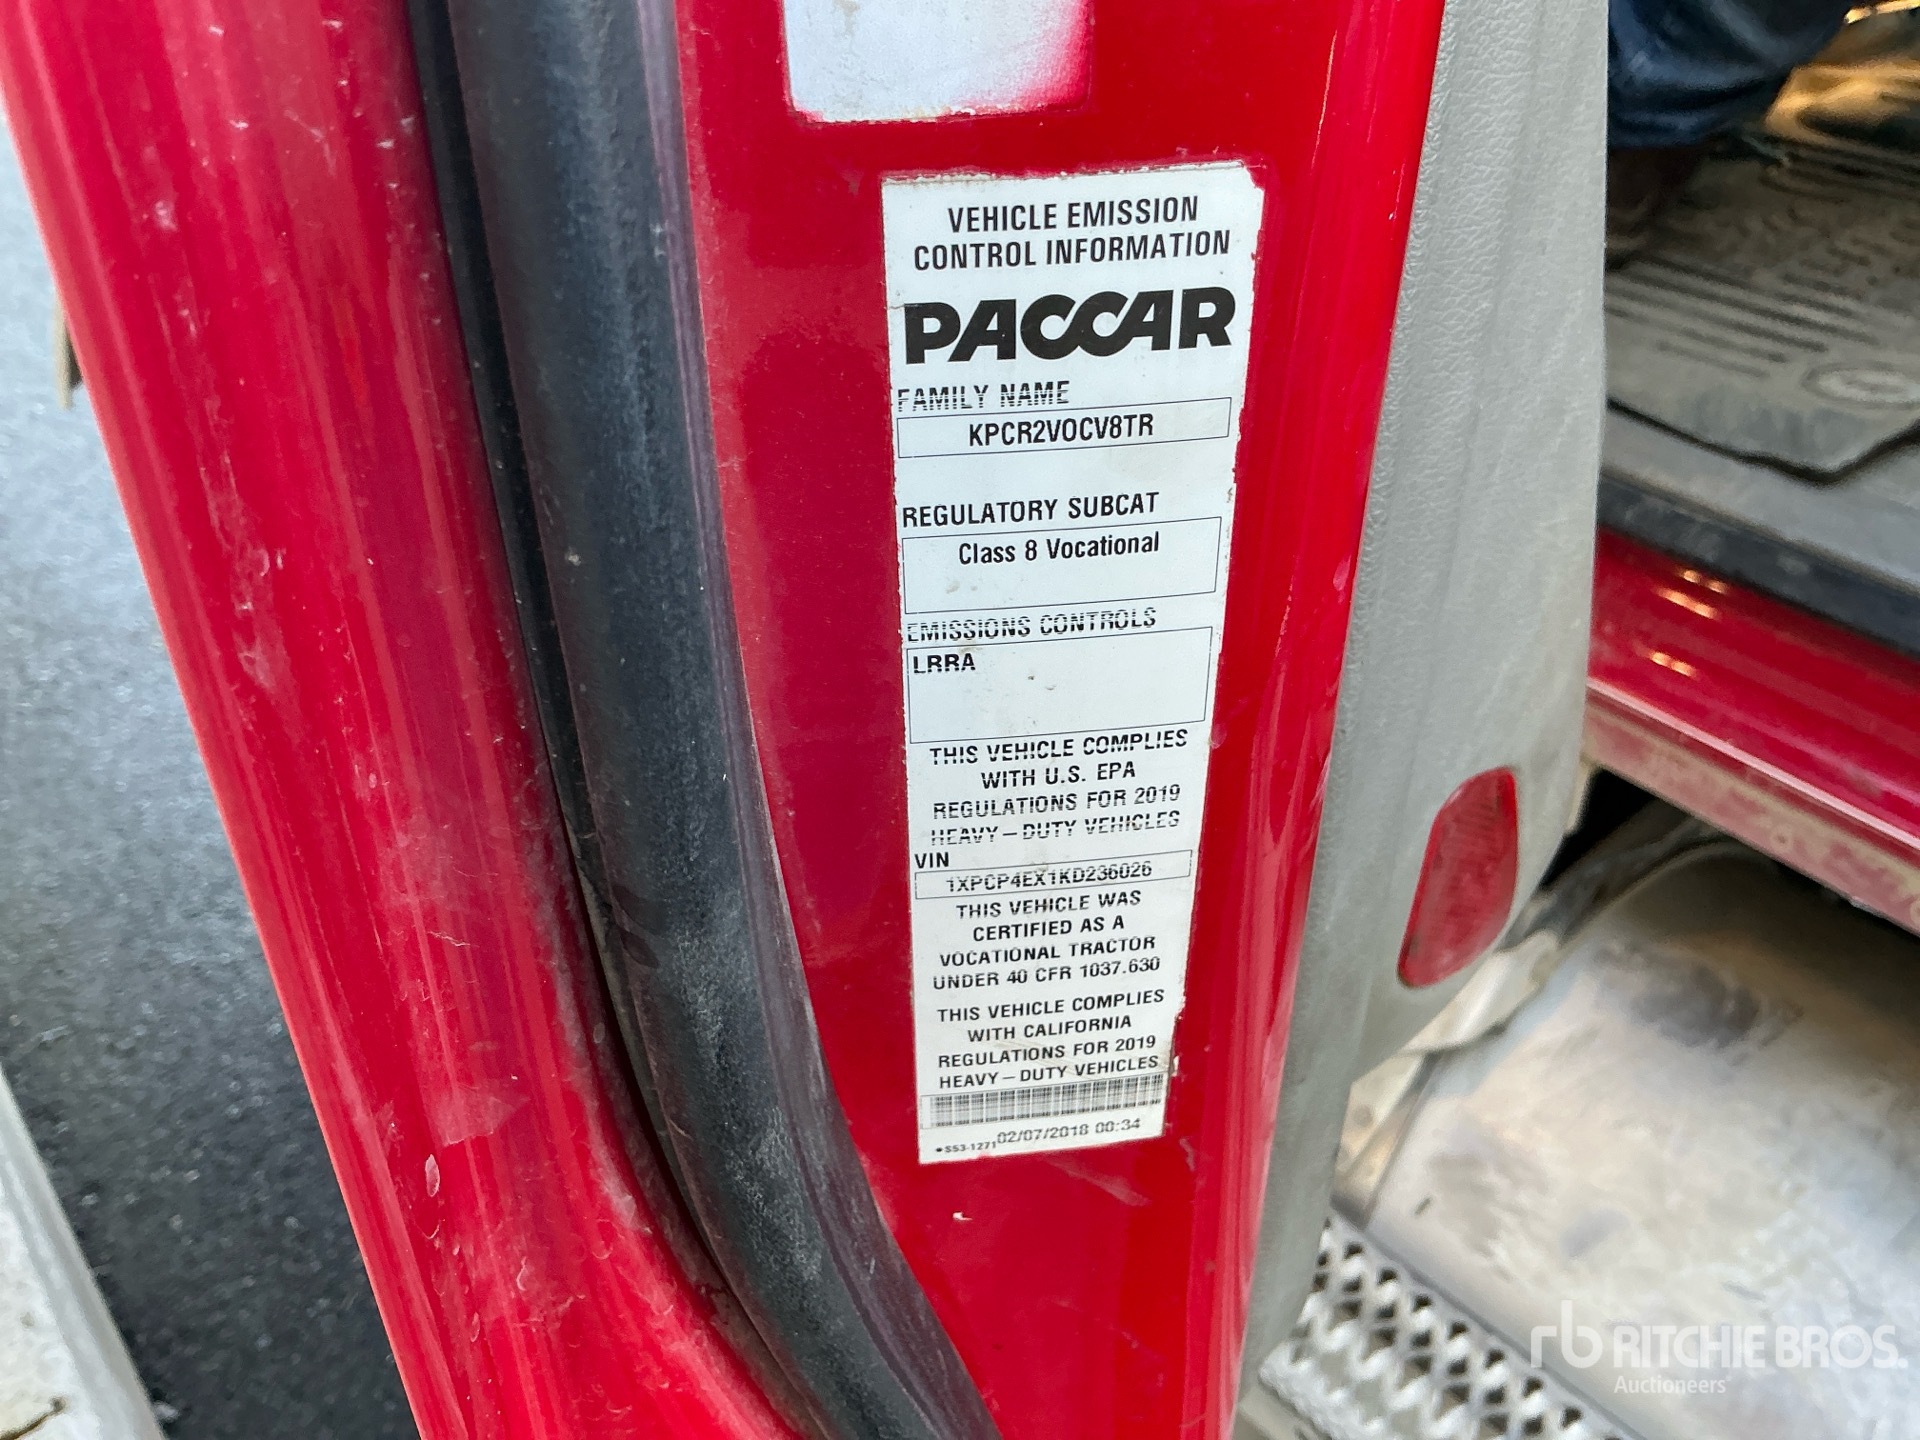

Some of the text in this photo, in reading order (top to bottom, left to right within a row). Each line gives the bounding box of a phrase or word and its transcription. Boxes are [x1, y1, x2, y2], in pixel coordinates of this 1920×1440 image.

[948, 196, 1198, 233] VEHICLE EMISSION
[914, 230, 1230, 270] CONTROL INFORMATION
[904, 286, 1236, 364] PACCAR
[898, 381, 1070, 412] FAMILY NAME
[903, 492, 1159, 527] REGULATORY SUBCAT
[959, 531, 1159, 564] Class 8 Vocational
[907, 608, 1156, 642] EMISSIONS CONTROLS
[930, 729, 1188, 765] THIS VEHICLE COMPLIES
[981, 762, 1136, 789] WITH U.S. EPA
[933, 784, 1180, 819] REGULATIONS FOR 2019
[1085, 811, 1180, 835] VEHICLES
[914, 852, 949, 869] VIN
[956, 890, 1142, 919] THIS VEHICLE WAS
[973, 916, 1124, 942] CERTIFIED AS A
[940, 937, 1156, 967] VOCATIONAL TRACTOR
[933, 957, 1161, 990] UNDER 40 CFR 1037.630
[938, 989, 1164, 1023] THIS VEHICLE COMPLIES
[968, 1015, 1132, 1042] WITH CALIFORNIA
[938, 1035, 1156, 1068] REGULATIONS FOR 2019
[1075, 1056, 1158, 1076] VEHICLES
[997, 1117, 1141, 1144] 02/07/2018 00:34
